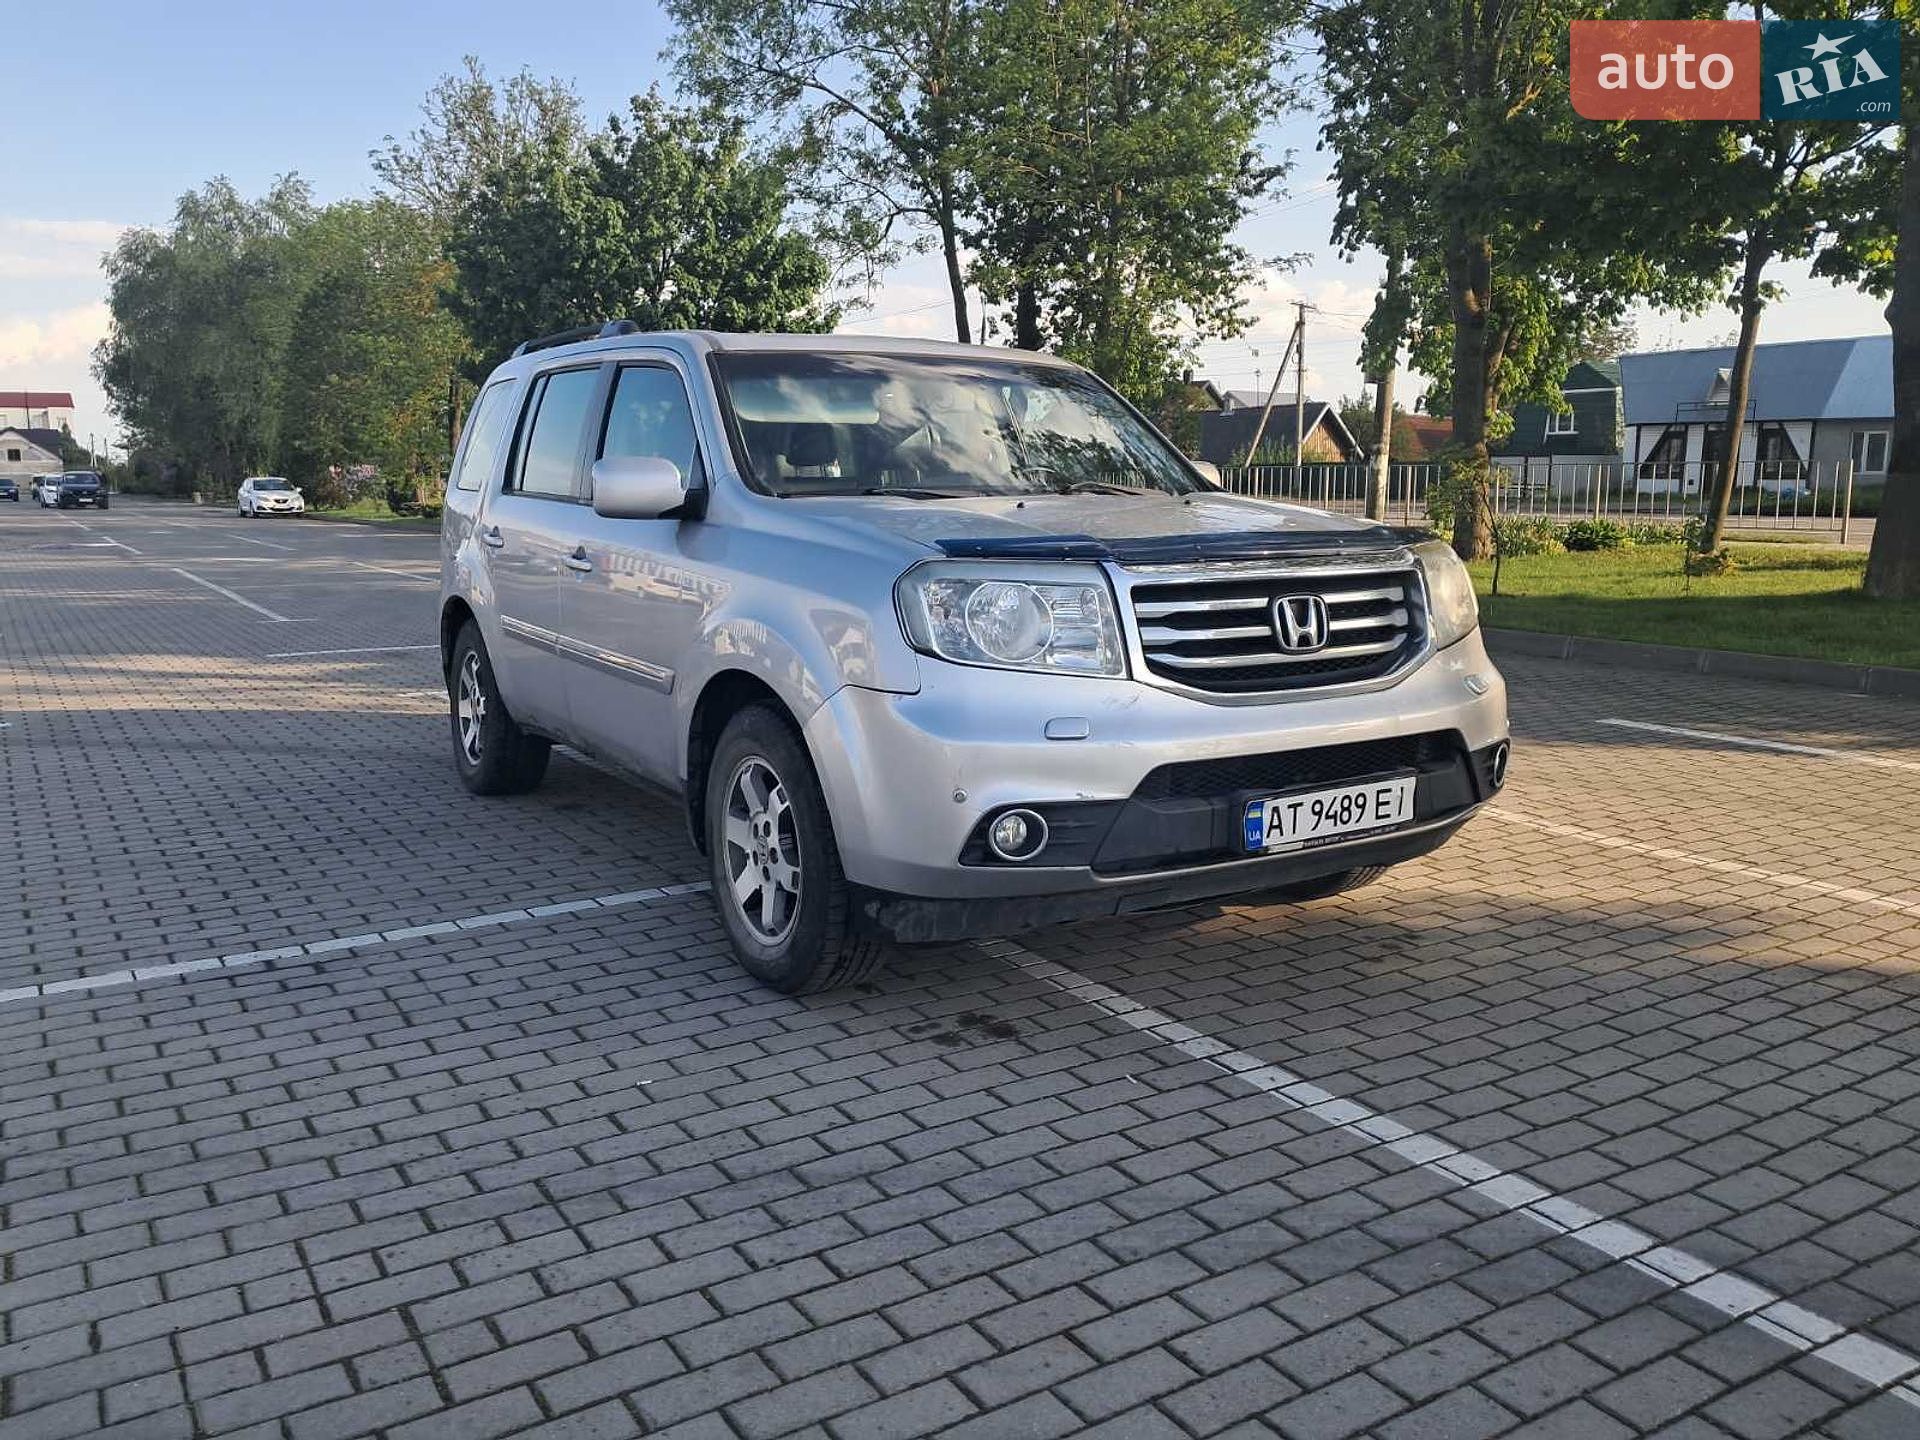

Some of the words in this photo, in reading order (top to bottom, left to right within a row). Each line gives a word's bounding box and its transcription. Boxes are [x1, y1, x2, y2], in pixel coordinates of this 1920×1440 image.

[1266, 802, 1304, 839] AT
[1311, 792, 1367, 831] 9489
[1375, 786, 1404, 820] EI
[1248, 830, 1262, 842] UA
